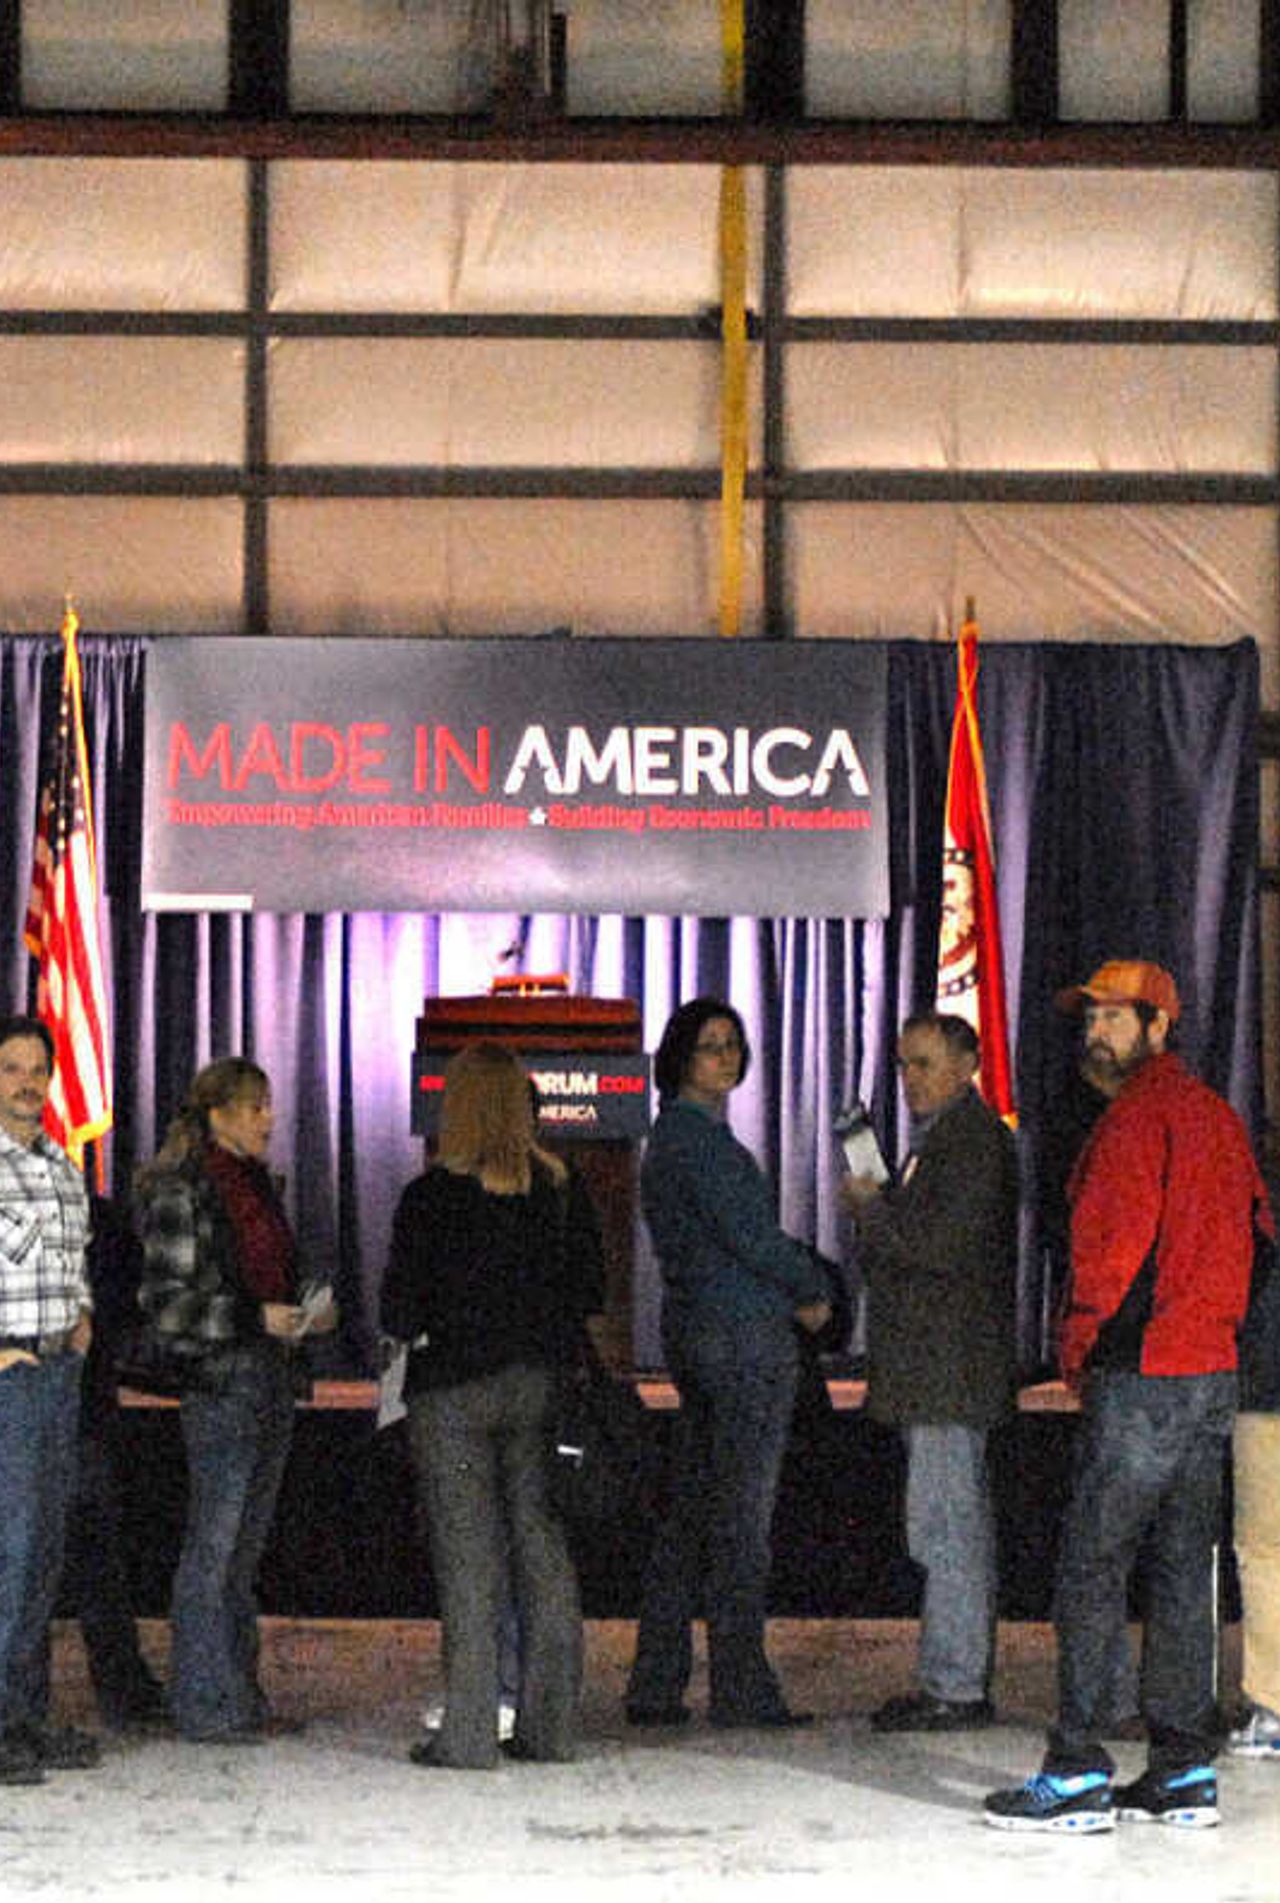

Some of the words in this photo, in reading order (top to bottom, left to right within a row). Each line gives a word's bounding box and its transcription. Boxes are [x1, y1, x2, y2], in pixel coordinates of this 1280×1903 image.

[168, 720, 392, 793] MADE
[413, 724, 491, 794] IN
[503, 725, 870, 797] AMERICA
